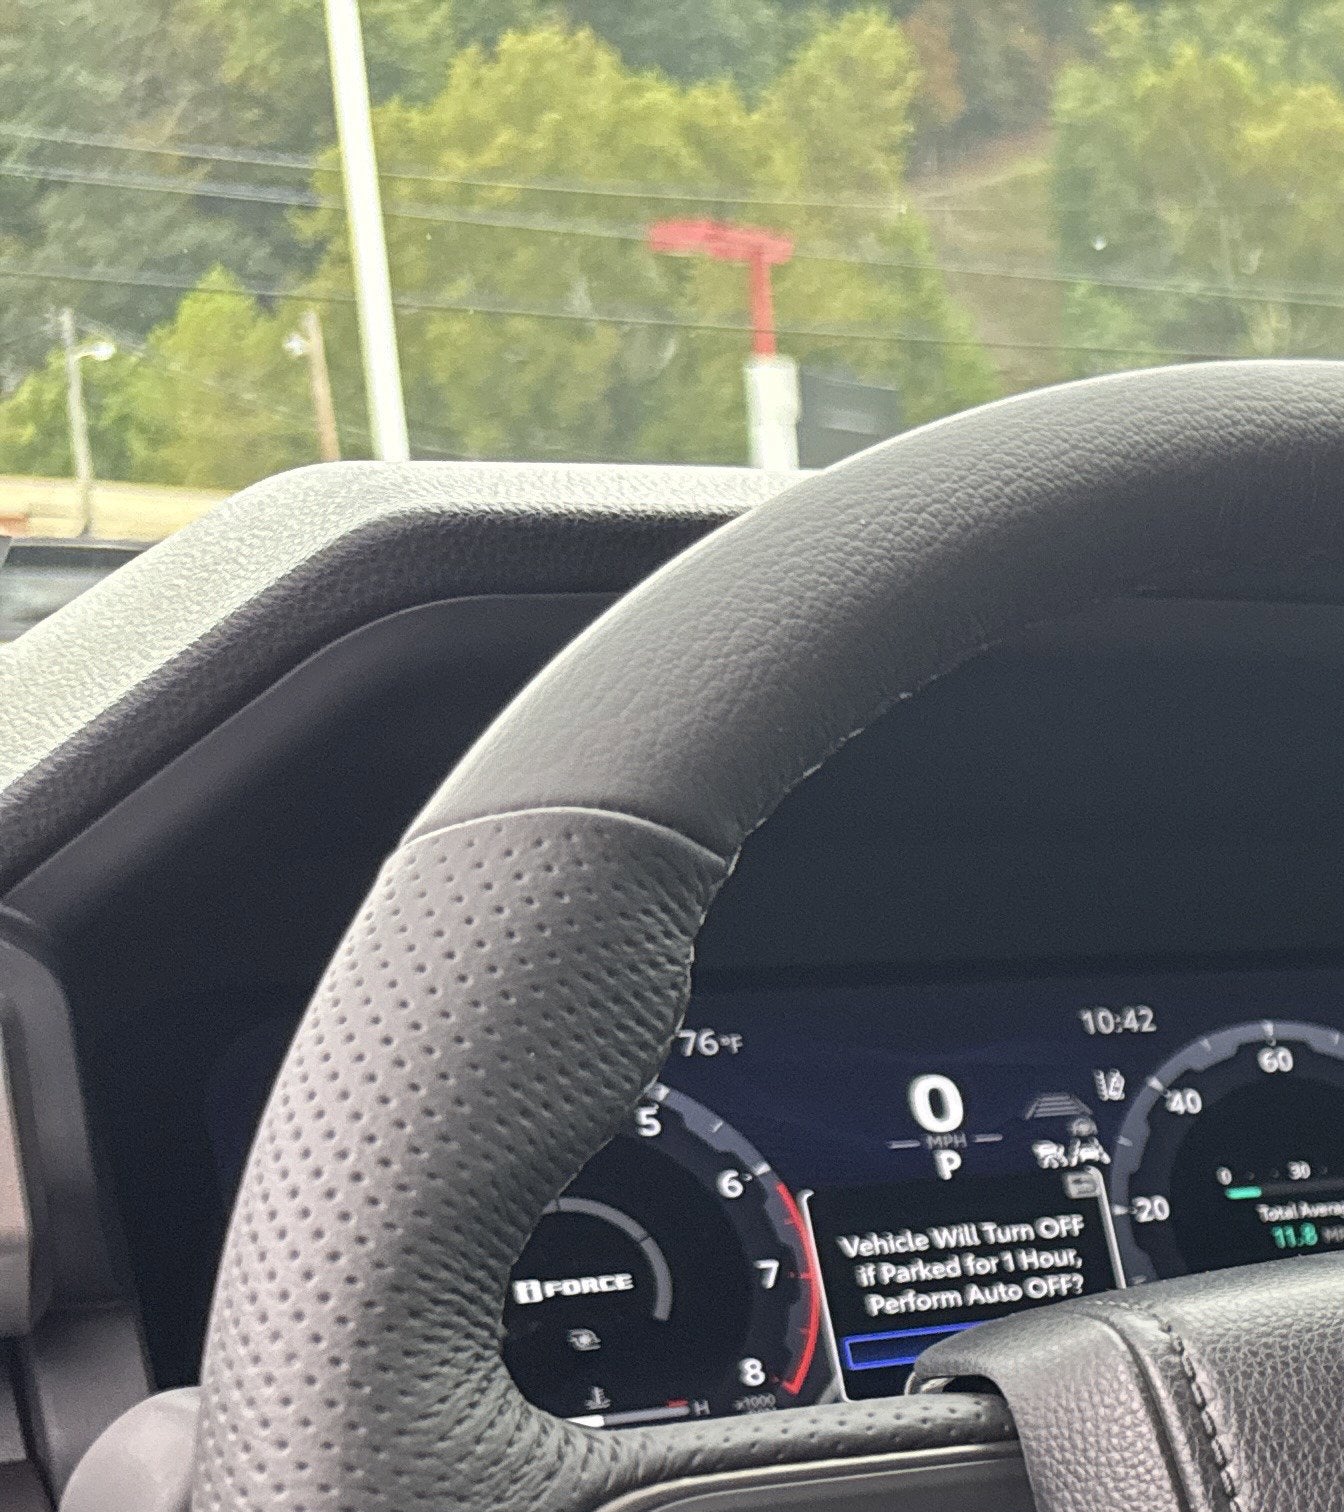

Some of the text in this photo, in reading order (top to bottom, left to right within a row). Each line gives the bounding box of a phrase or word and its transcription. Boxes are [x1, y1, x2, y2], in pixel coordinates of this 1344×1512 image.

[1079, 1006, 1157, 1035] 10:42
[1257, 1046, 1293, 1073] 60
[908, 1074, 964, 1133] 0
[1166, 1087, 1202, 1114] 40
[635, 1105, 662, 1137] 5
[924, 1133, 967, 1149] MPH
[935, 1150, 962, 1181] P
[1287, 1160, 1311, 1180] 30
[716, 1171, 743, 1198] 6
[1134, 1194, 1170, 1222] 20
[1256, 1202, 1298, 1222] Total
[836, 1214, 1084, 1258] Vehicle Will Turn OFF
[753, 1258, 779, 1289] 7
[855, 1247, 1083, 1288] if Parked for 1 Hour,
[864, 1273, 1083, 1317] Perform Auto OFF?
[738, 1358, 766, 1386] 8
[691, 1400, 710, 1416] H
